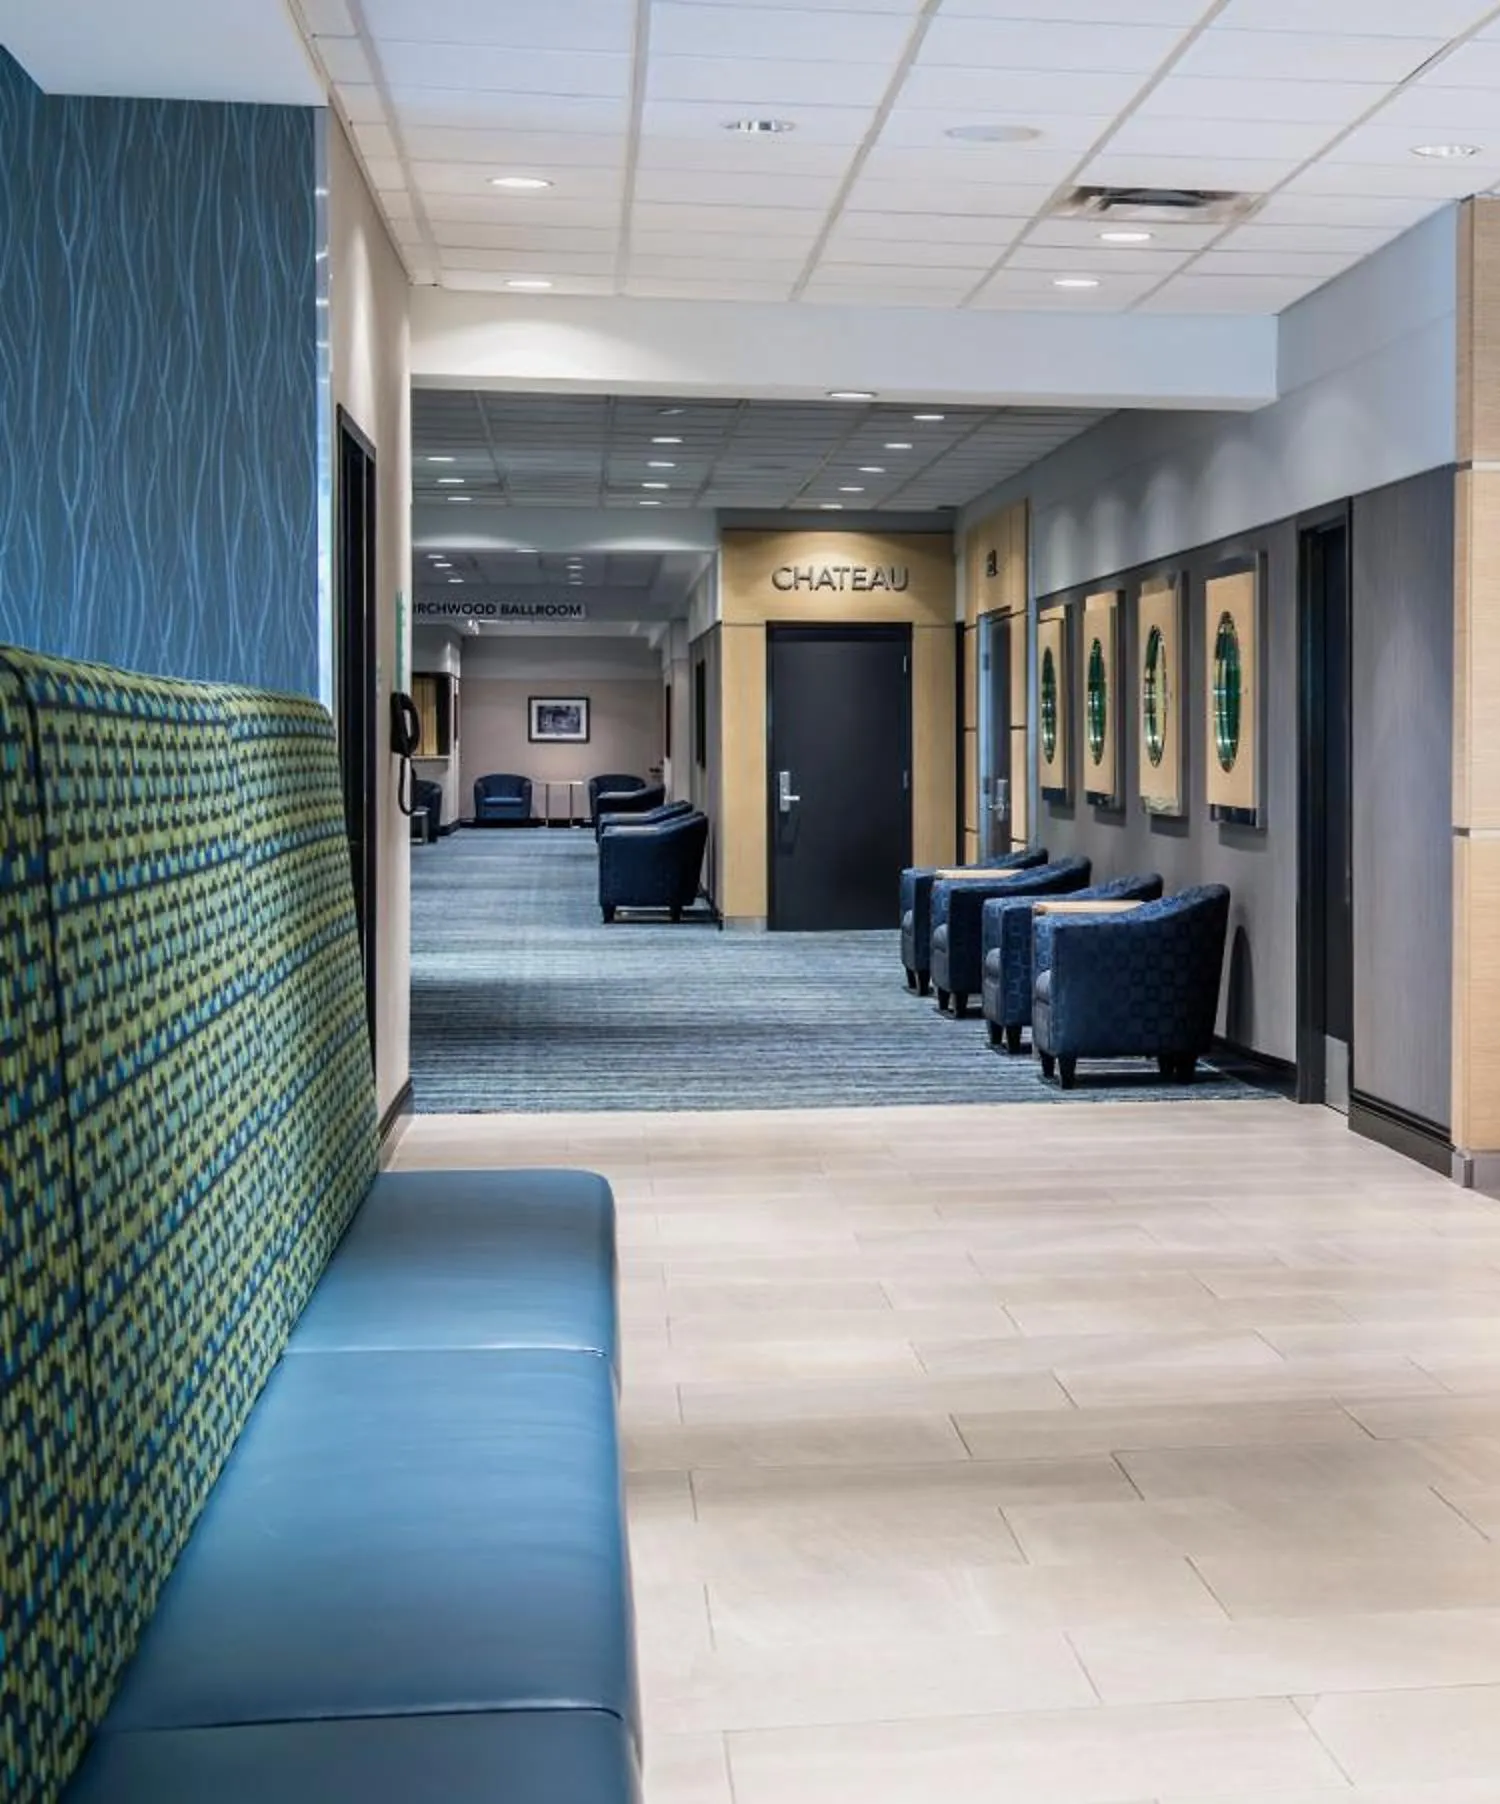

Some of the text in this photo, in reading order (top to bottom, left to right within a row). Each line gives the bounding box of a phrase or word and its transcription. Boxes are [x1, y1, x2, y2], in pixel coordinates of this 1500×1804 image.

[771, 565, 909, 592] CHATEAU
[412, 602, 583, 616] IRCHWOOD BALLROOM
